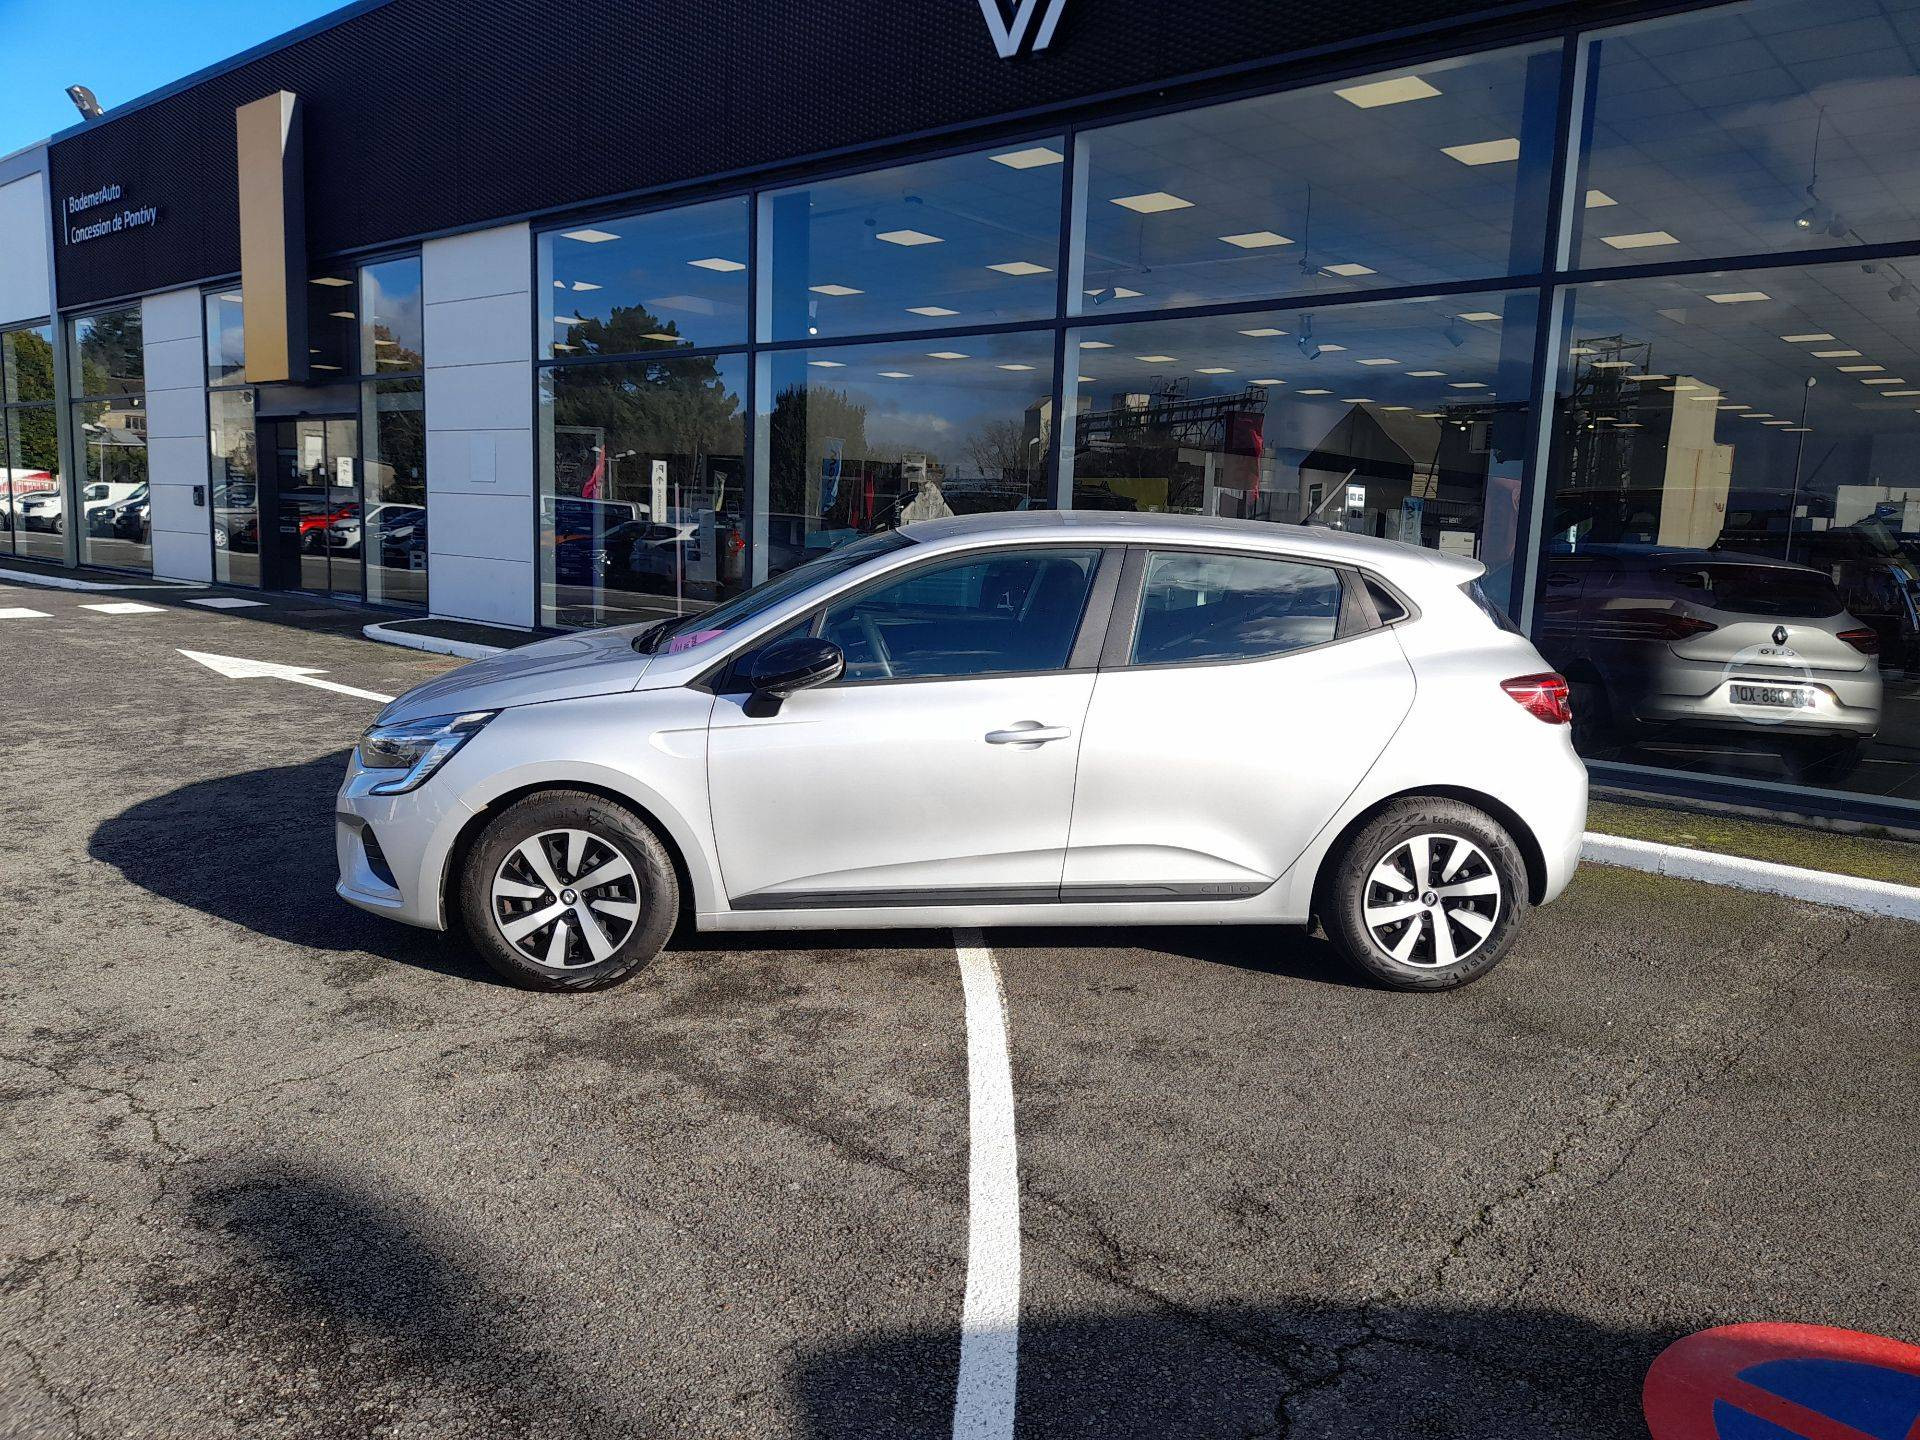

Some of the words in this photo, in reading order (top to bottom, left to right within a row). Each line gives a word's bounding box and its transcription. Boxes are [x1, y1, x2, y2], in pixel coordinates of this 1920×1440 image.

[69, 183, 121, 214] BodemerAuto
[71, 218, 112, 244] Concession
[112, 212, 123, 231] de
[124, 204, 157, 228] Pontivy
